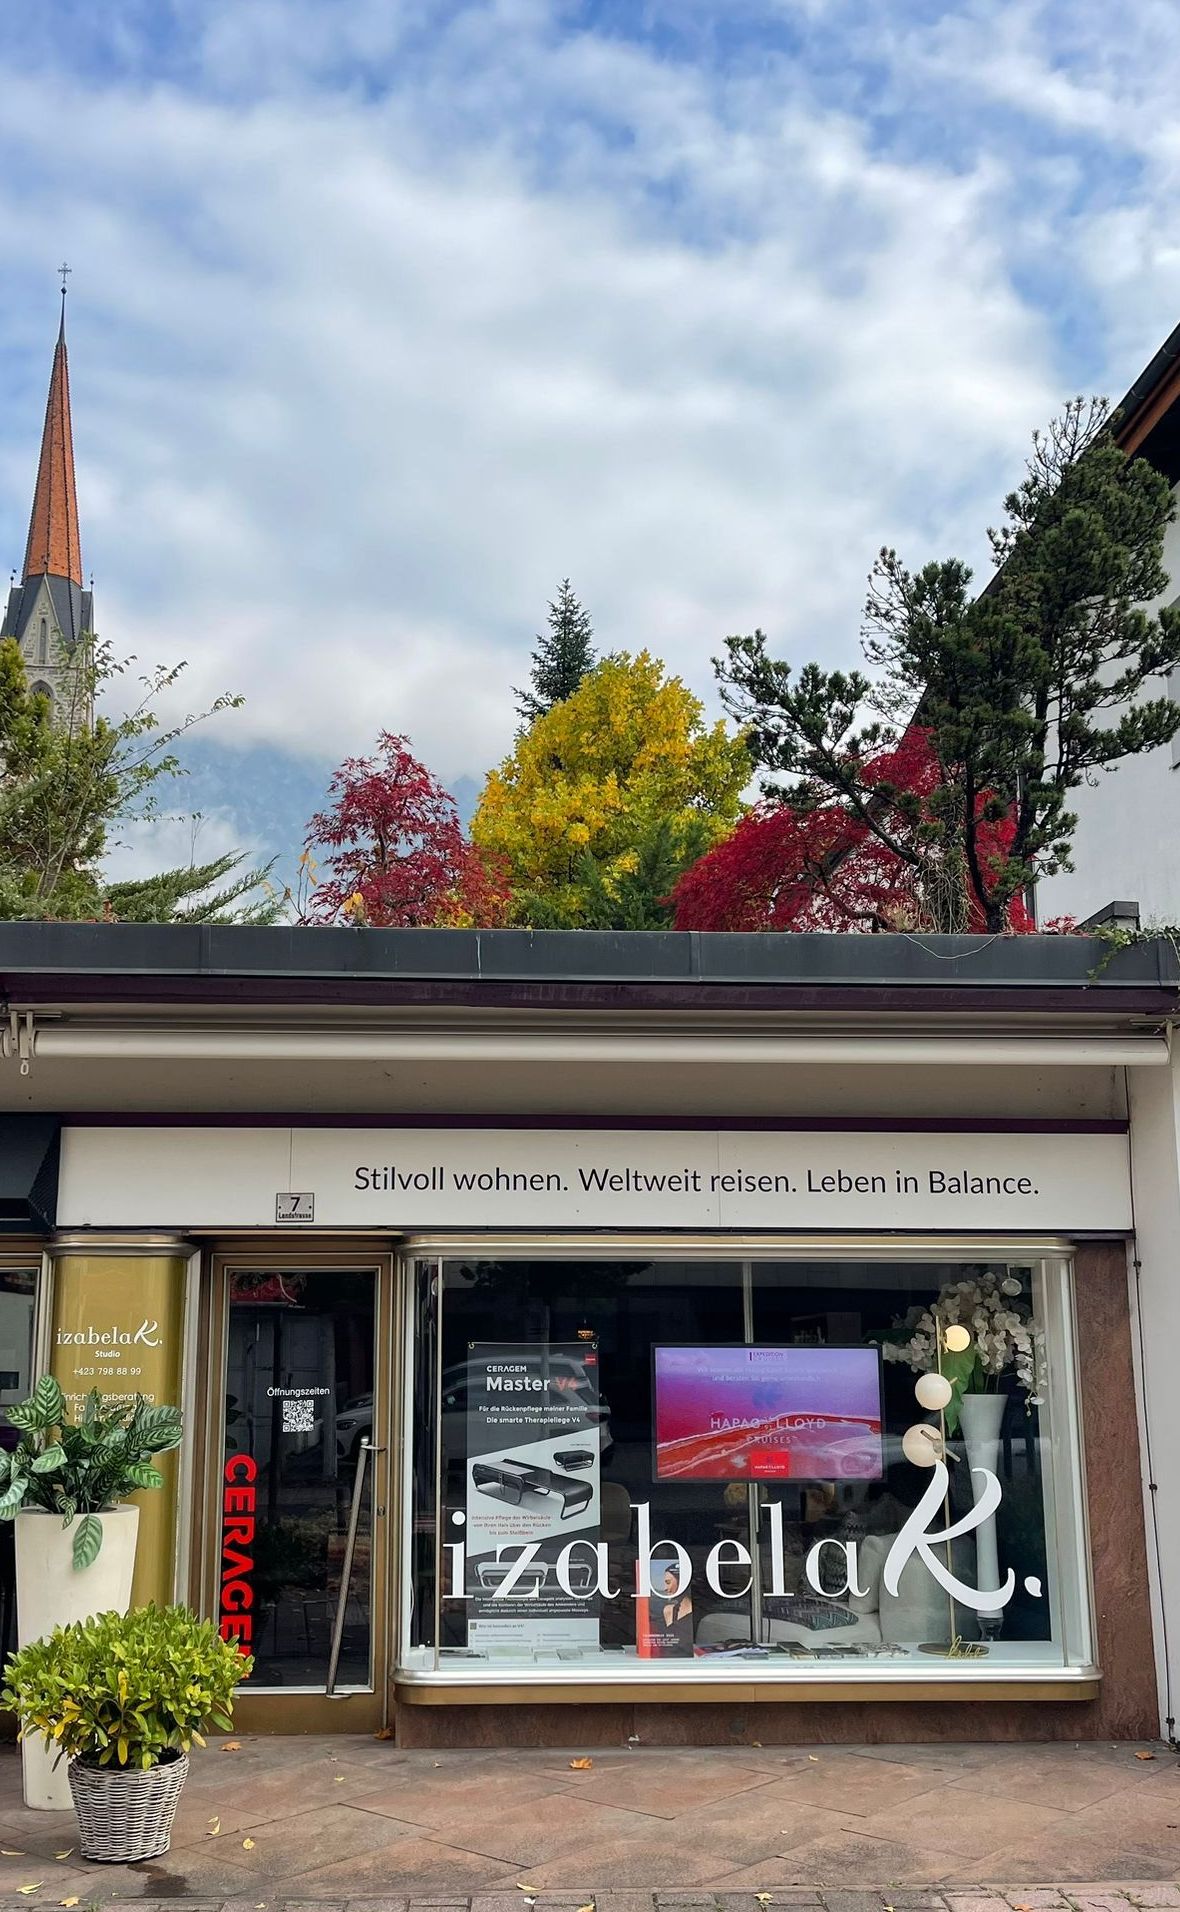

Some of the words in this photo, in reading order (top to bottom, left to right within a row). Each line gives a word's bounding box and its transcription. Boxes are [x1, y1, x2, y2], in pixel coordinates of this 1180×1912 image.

[354, 1166, 444, 1190] Stilvoll
[453, 1167, 568, 1191] wohnen.
[578, 1168, 701, 1192] Weltweit
[711, 1169, 797, 1193] reisen.
[807, 1170, 886, 1193] Leben
[896, 1170, 918, 1193] in
[929, 1171, 1039, 1195] Balance.
[290, 1196, 301, 1212] 7
[94, 1349, 121, 1359] Studio
[72, 1367, 95, 1376] +423
[98, 1367, 114, 1376] 798
[116, 1367, 128, 1376] 88
[130, 1367, 142, 1376] 99
[486, 1365, 527, 1373] CERAGEM
[486, 1376, 551, 1392] Master
[267, 1386, 330, 1398] Öffnungszeiten
[220, 1454, 257, 1681] CERAGE
